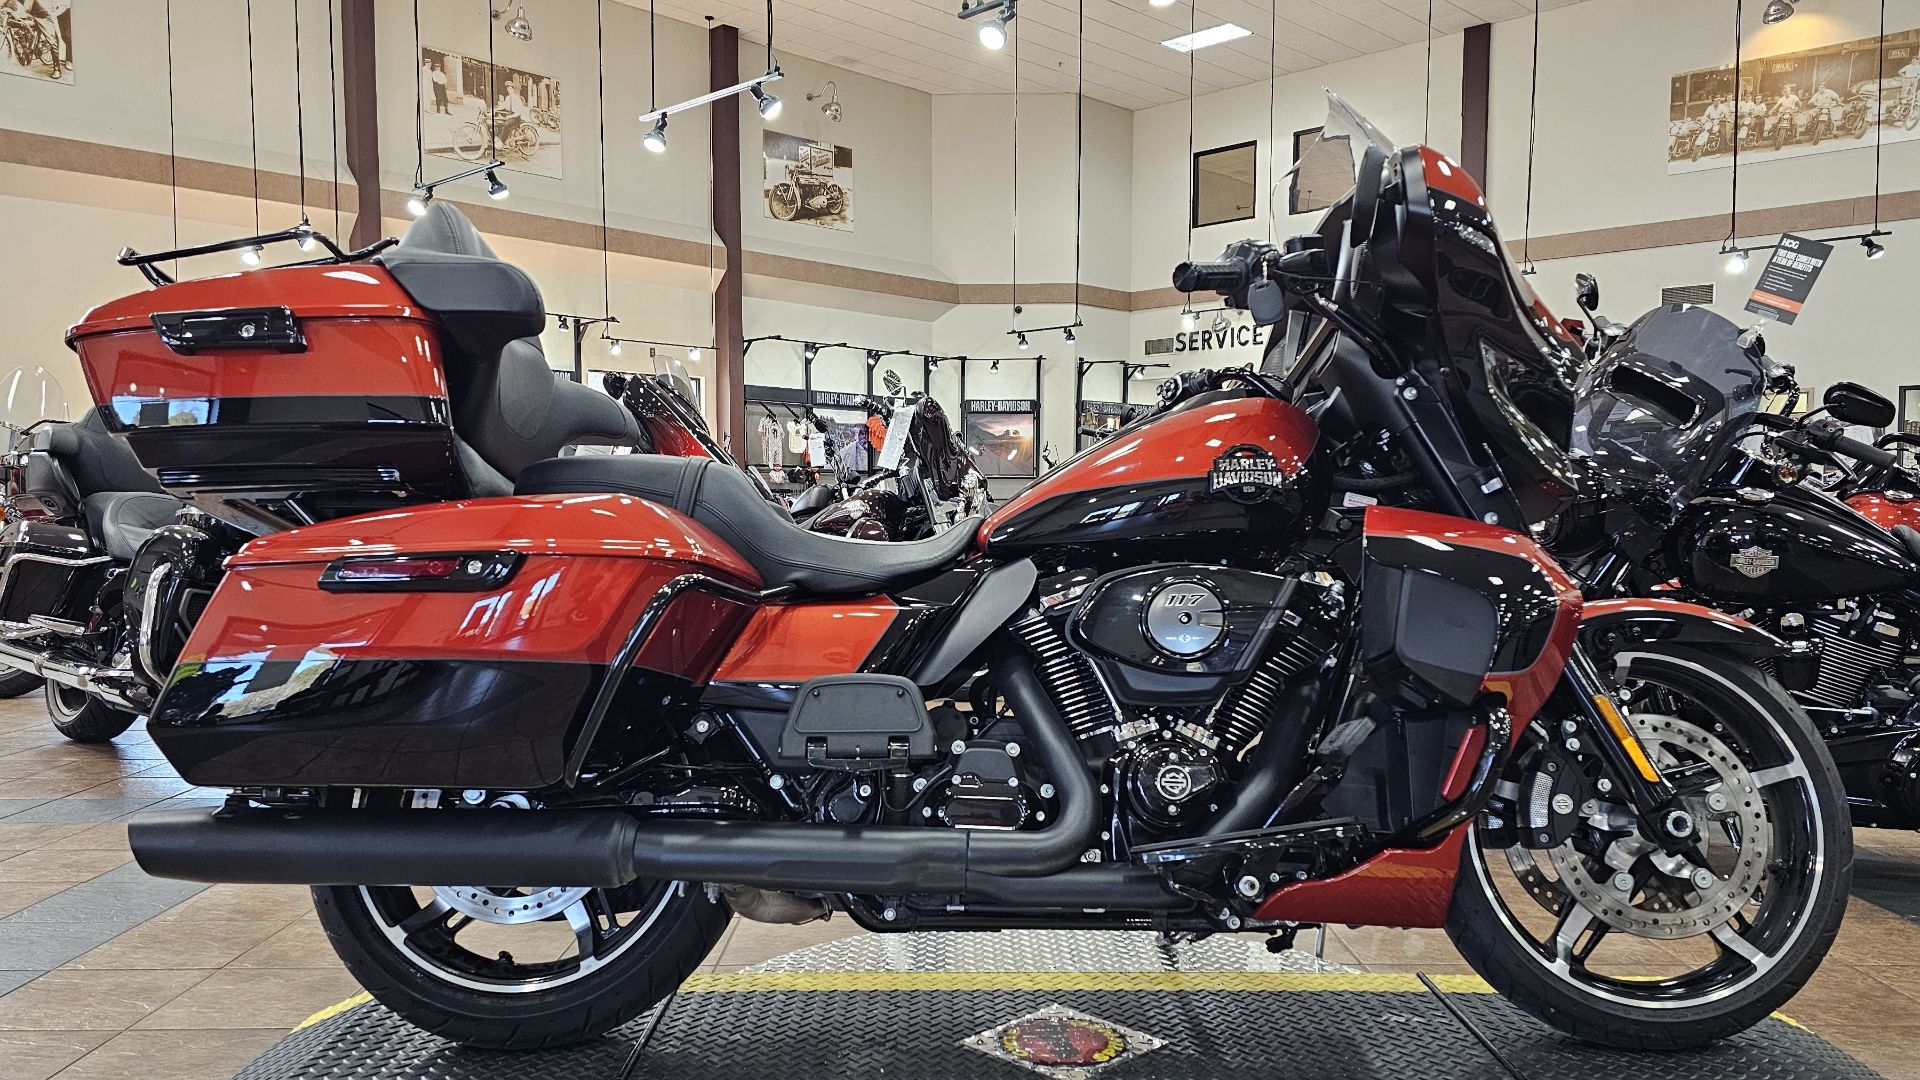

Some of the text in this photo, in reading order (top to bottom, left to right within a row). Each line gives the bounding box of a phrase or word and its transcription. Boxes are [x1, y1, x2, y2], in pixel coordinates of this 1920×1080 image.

[1781, 238, 1800, 250] HOG
[1175, 325, 1264, 352] SERVICE
[816, 391, 867, 407] HARLEY-DAVIDS
[971, 400, 1032, 412] HARLEY-DAVIDSON
[1212, 471, 1282, 490] DAVIDSON
[1164, 592, 1209, 607] 117
